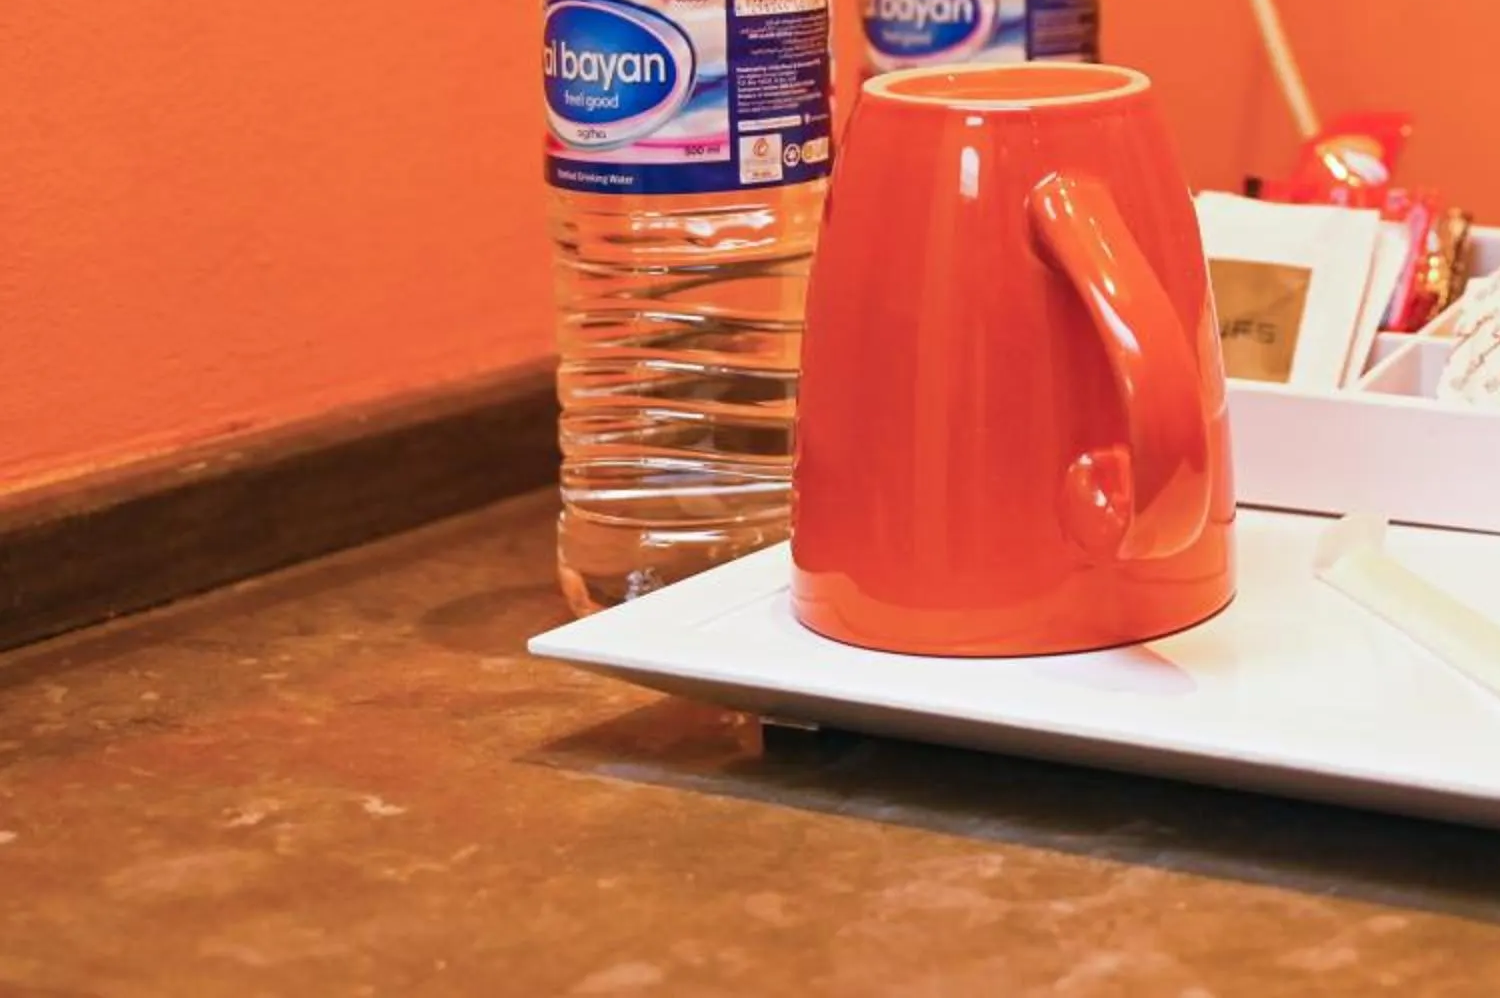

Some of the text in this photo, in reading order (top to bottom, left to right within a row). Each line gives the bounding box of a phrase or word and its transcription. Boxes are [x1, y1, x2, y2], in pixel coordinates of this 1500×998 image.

[561, 42, 666, 90] bayan
[565, 90, 619, 111] feel good
[609, 174, 634, 185] Water
